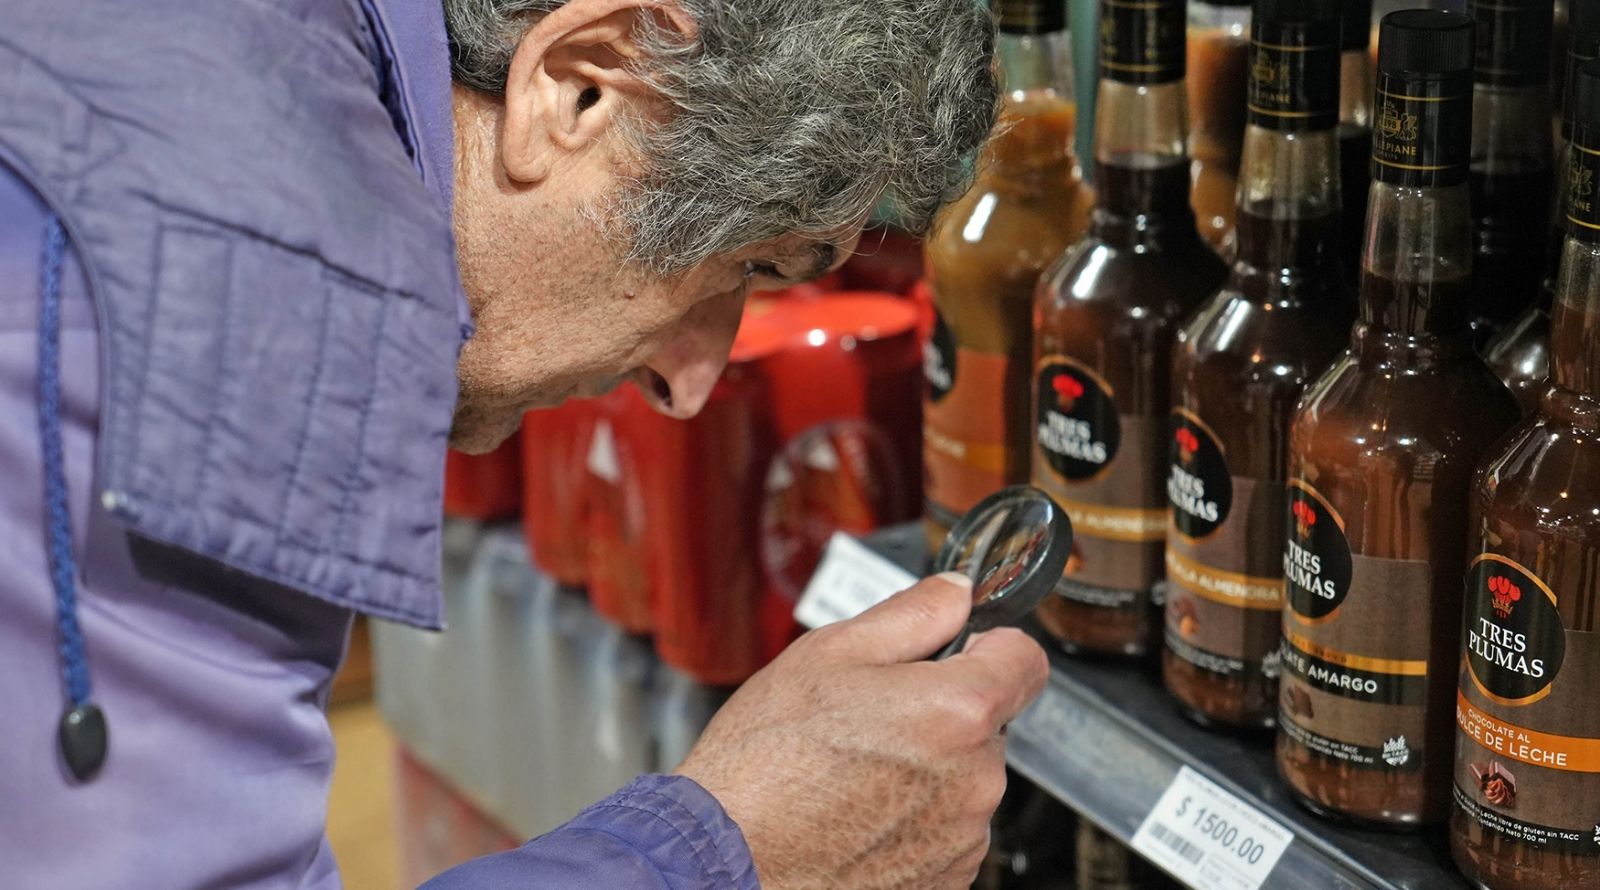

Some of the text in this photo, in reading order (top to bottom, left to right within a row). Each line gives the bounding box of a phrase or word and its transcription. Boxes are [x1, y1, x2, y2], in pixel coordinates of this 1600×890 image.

[1288, 539, 1321, 575] TRES
[1199, 574, 1279, 600] ALMENDRA
[1480, 617, 1527, 653] TRES
[1469, 629, 1545, 678] PLUMAS
[1308, 664, 1378, 694] AMARGO
[1468, 708, 1531, 744] CHOCOLATE AL
[1485, 732, 1504, 751] DE
[1509, 742, 1568, 767] LECHE
[1175, 795, 1191, 817] $
[1193, 807, 1265, 865] 1500.00
[1505, 828, 1522, 838] Neto
[1522, 833, 1537, 842] 700
[1537, 837, 1548, 845] ml
[1513, 823, 1522, 831] de
[1523, 826, 1546, 836] gluten
[1559, 832, 1580, 841] TACC
